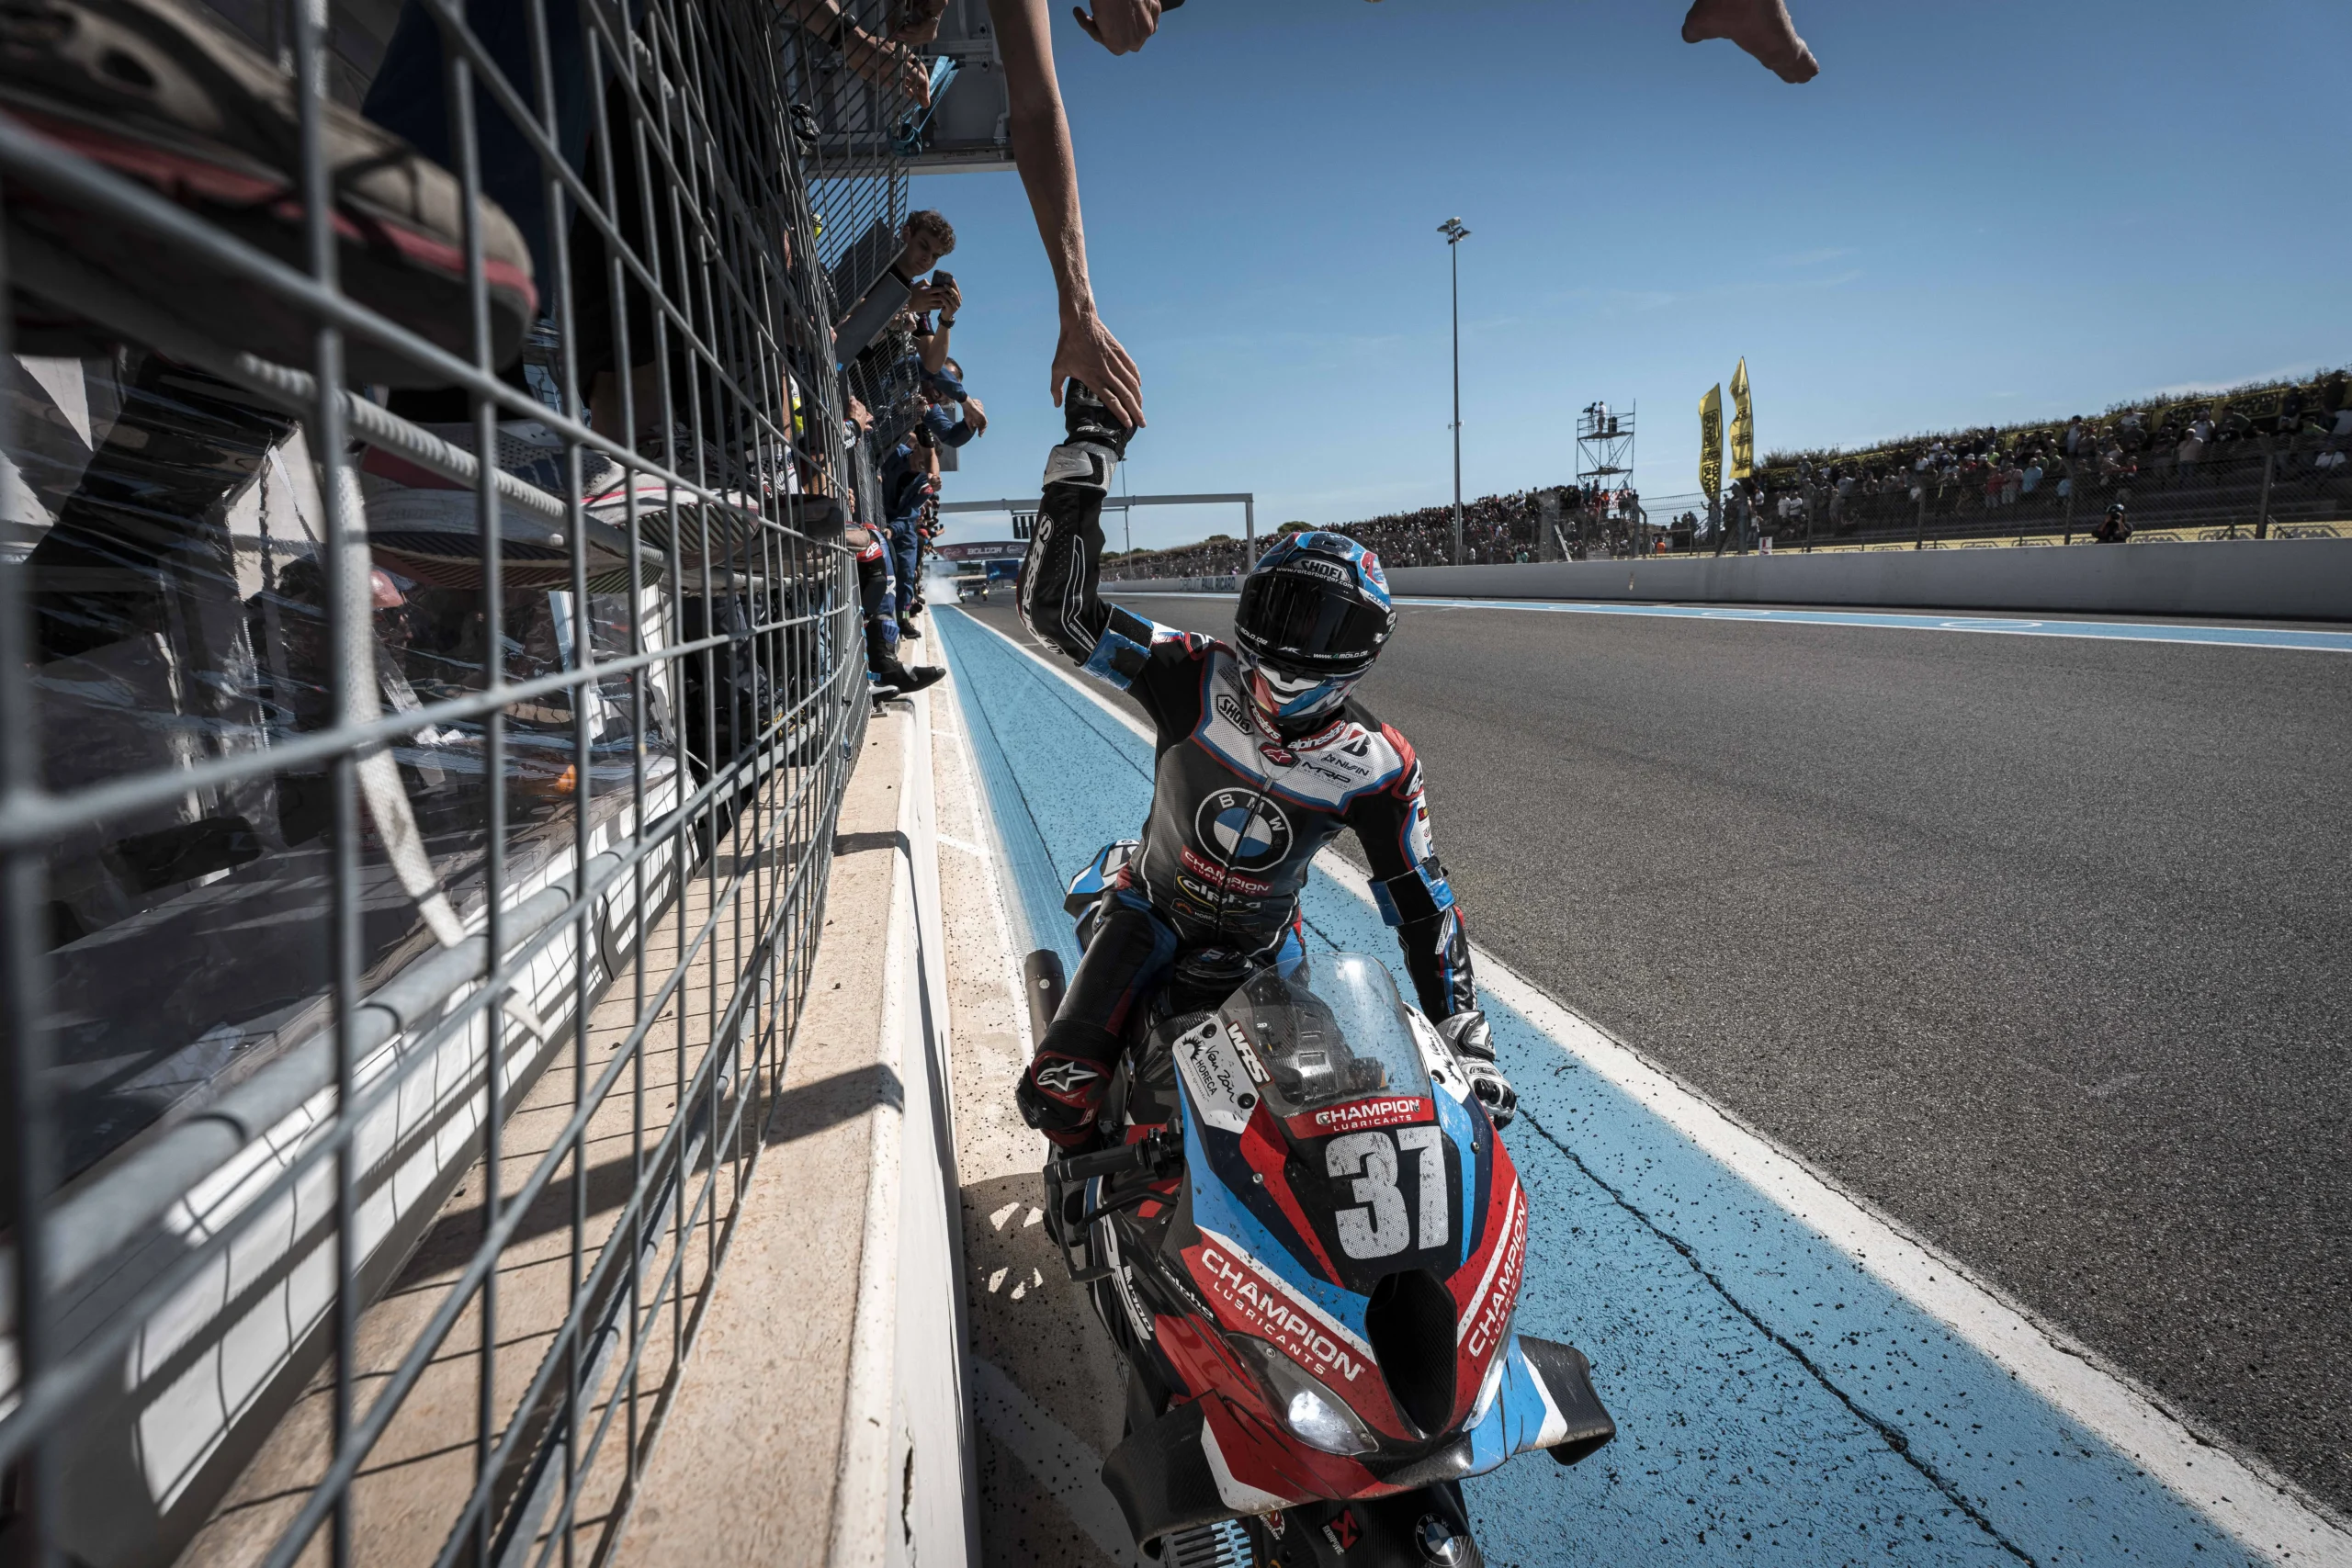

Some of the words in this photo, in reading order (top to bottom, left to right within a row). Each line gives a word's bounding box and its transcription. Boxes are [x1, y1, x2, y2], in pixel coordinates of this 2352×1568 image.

[1216, 576, 1236, 591] RICARD
[1276, 566, 1354, 590] www.reiterberger.com
[1300, 559, 1342, 580] SHOEI
[1250, 702, 1282, 740] nestars
[1287, 719, 1346, 750] alpinestars
[1184, 851, 1270, 892] CHAMPION
[1227, 1022, 1271, 1083] WRS
[1195, 1059, 1218, 1096] HORECA
[1316, 1099, 1420, 1125] CHAMPION
[1333, 1114, 1413, 1132] LUBRICANTS
[1325, 1125, 1449, 1260] 37
[1469, 1203, 1526, 1357] CHAMPION
[1201, 1248, 1362, 1382] CHAMPION
[1213, 1281, 1326, 1375] LUBRICANTS
